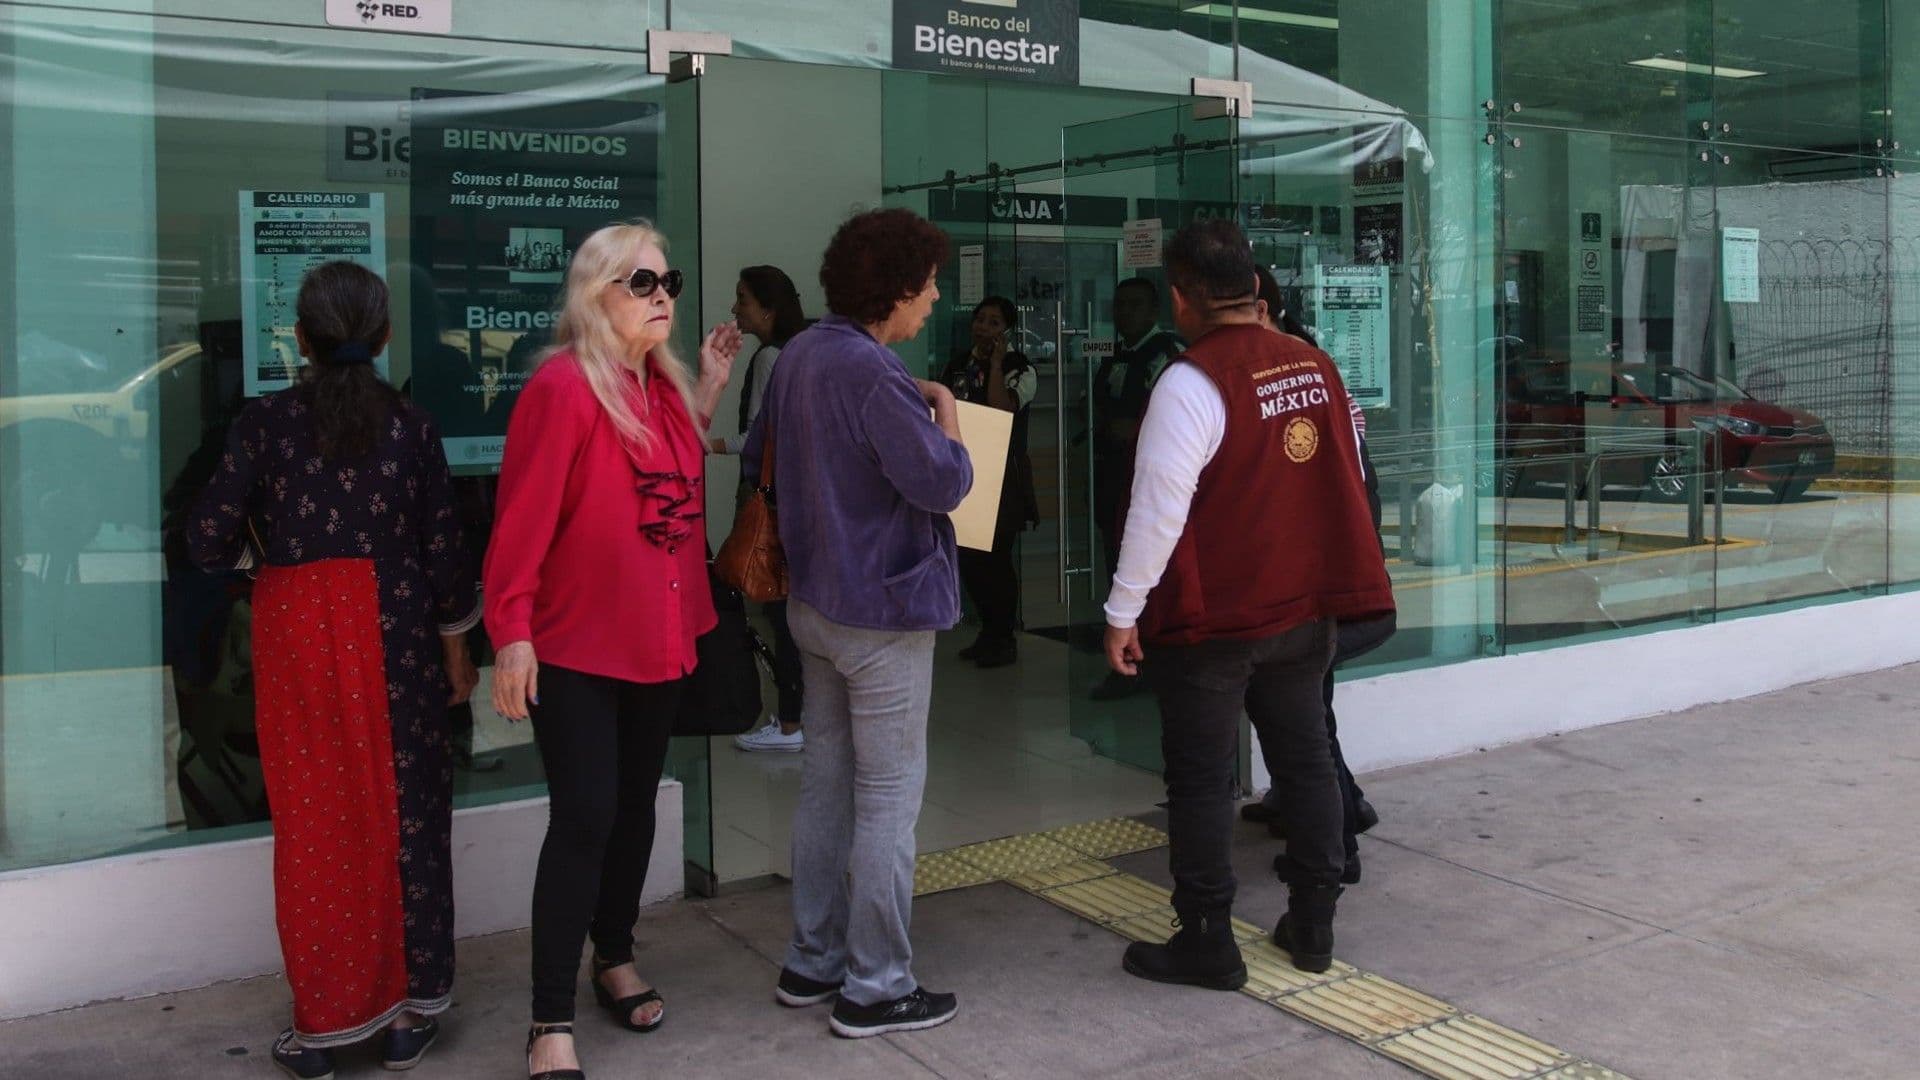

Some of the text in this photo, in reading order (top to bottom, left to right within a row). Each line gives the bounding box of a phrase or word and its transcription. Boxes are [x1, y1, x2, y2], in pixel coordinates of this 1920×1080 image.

[382, 4, 418, 18] RED
[947, 10, 1030, 33] Banco del
[915, 24, 1060, 65] Bienestar
[950, 58, 973, 68] banco
[985, 62, 996, 71] los
[997, 64, 1036, 74] mexicanos
[443, 128, 628, 156] BIENVENIDOS
[452, 171, 620, 190] Somos el Banco Social
[268, 193, 356, 204] CALENDARIO
[450, 190, 620, 210] más grande de México
[992, 198, 1052, 220] CAJA
[259, 229, 285, 237] AMOR
[1083, 342, 1112, 352] EMPUJE
[1252, 365, 1281, 380] SERVIDOR
[1256, 373, 1313, 398] GOBIERNO
